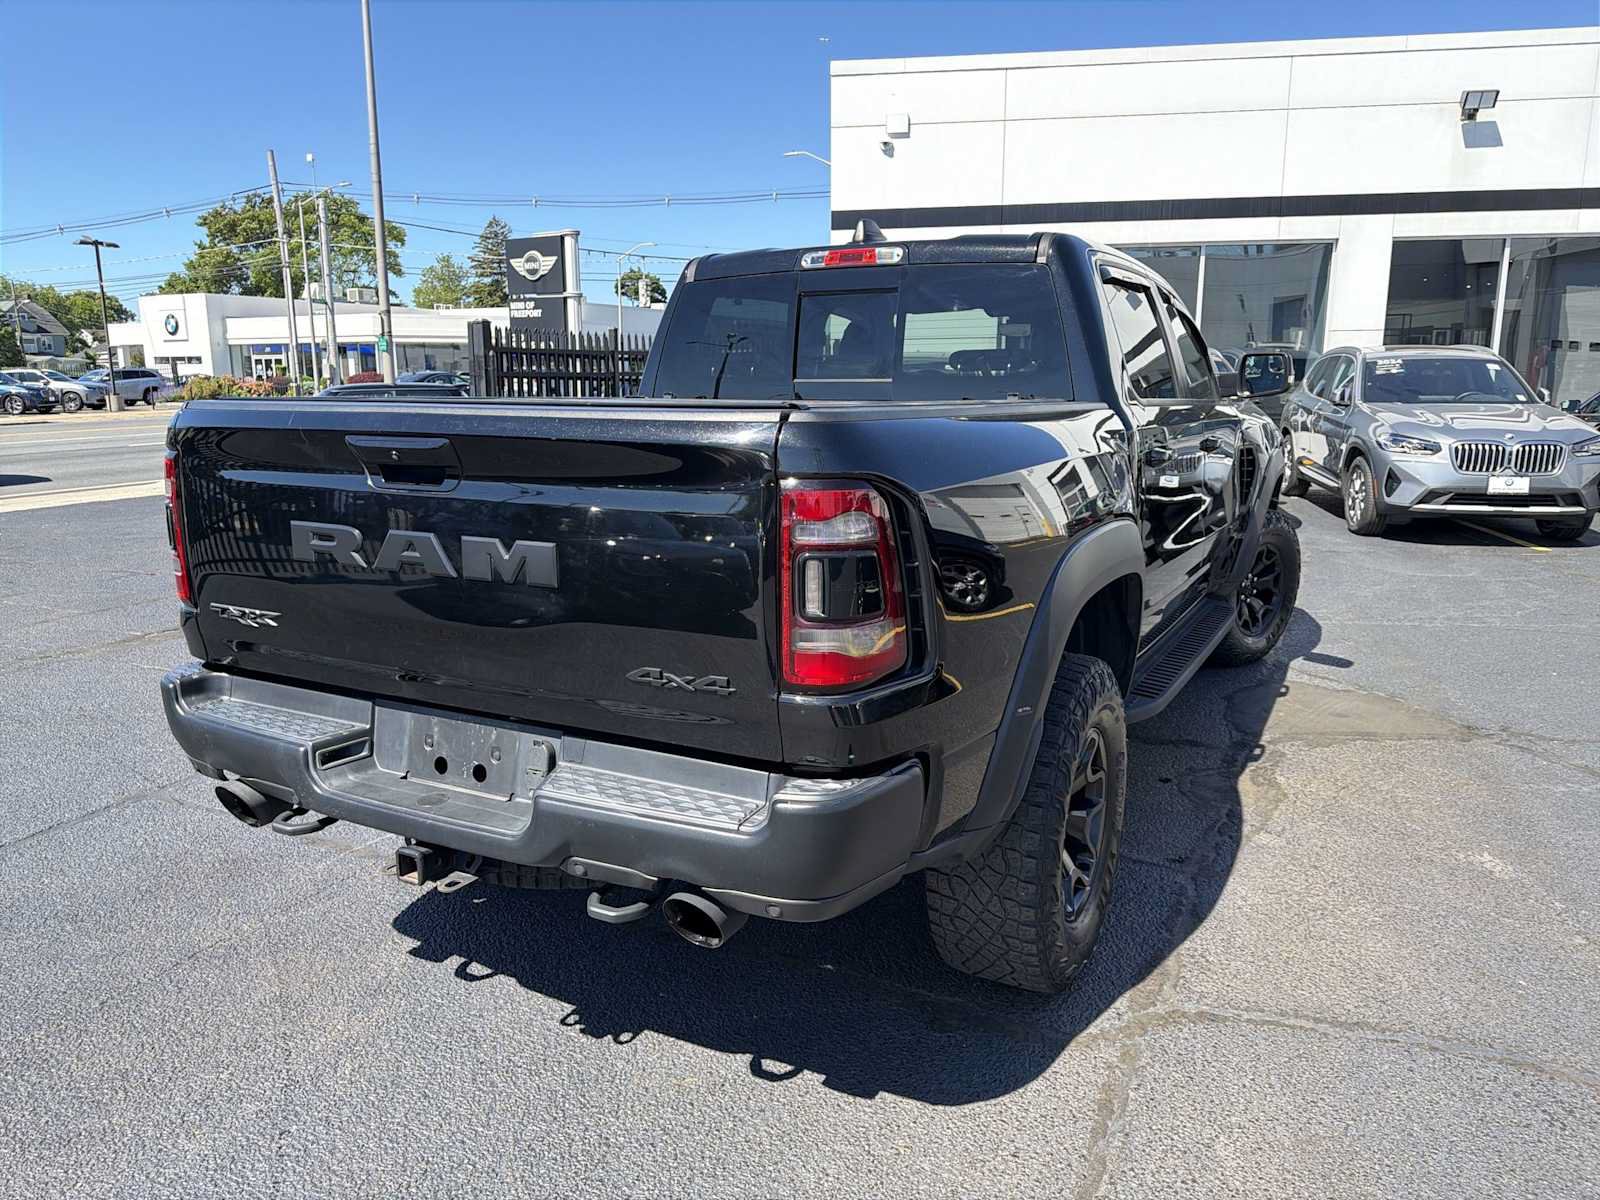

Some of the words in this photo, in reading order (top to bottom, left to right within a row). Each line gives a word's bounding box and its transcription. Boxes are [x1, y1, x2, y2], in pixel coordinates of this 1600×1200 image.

[524, 262, 540, 270] MINI
[525, 301, 535, 309] OF
[290, 520, 559, 588] RAM
[209, 602, 281, 627] TRX
